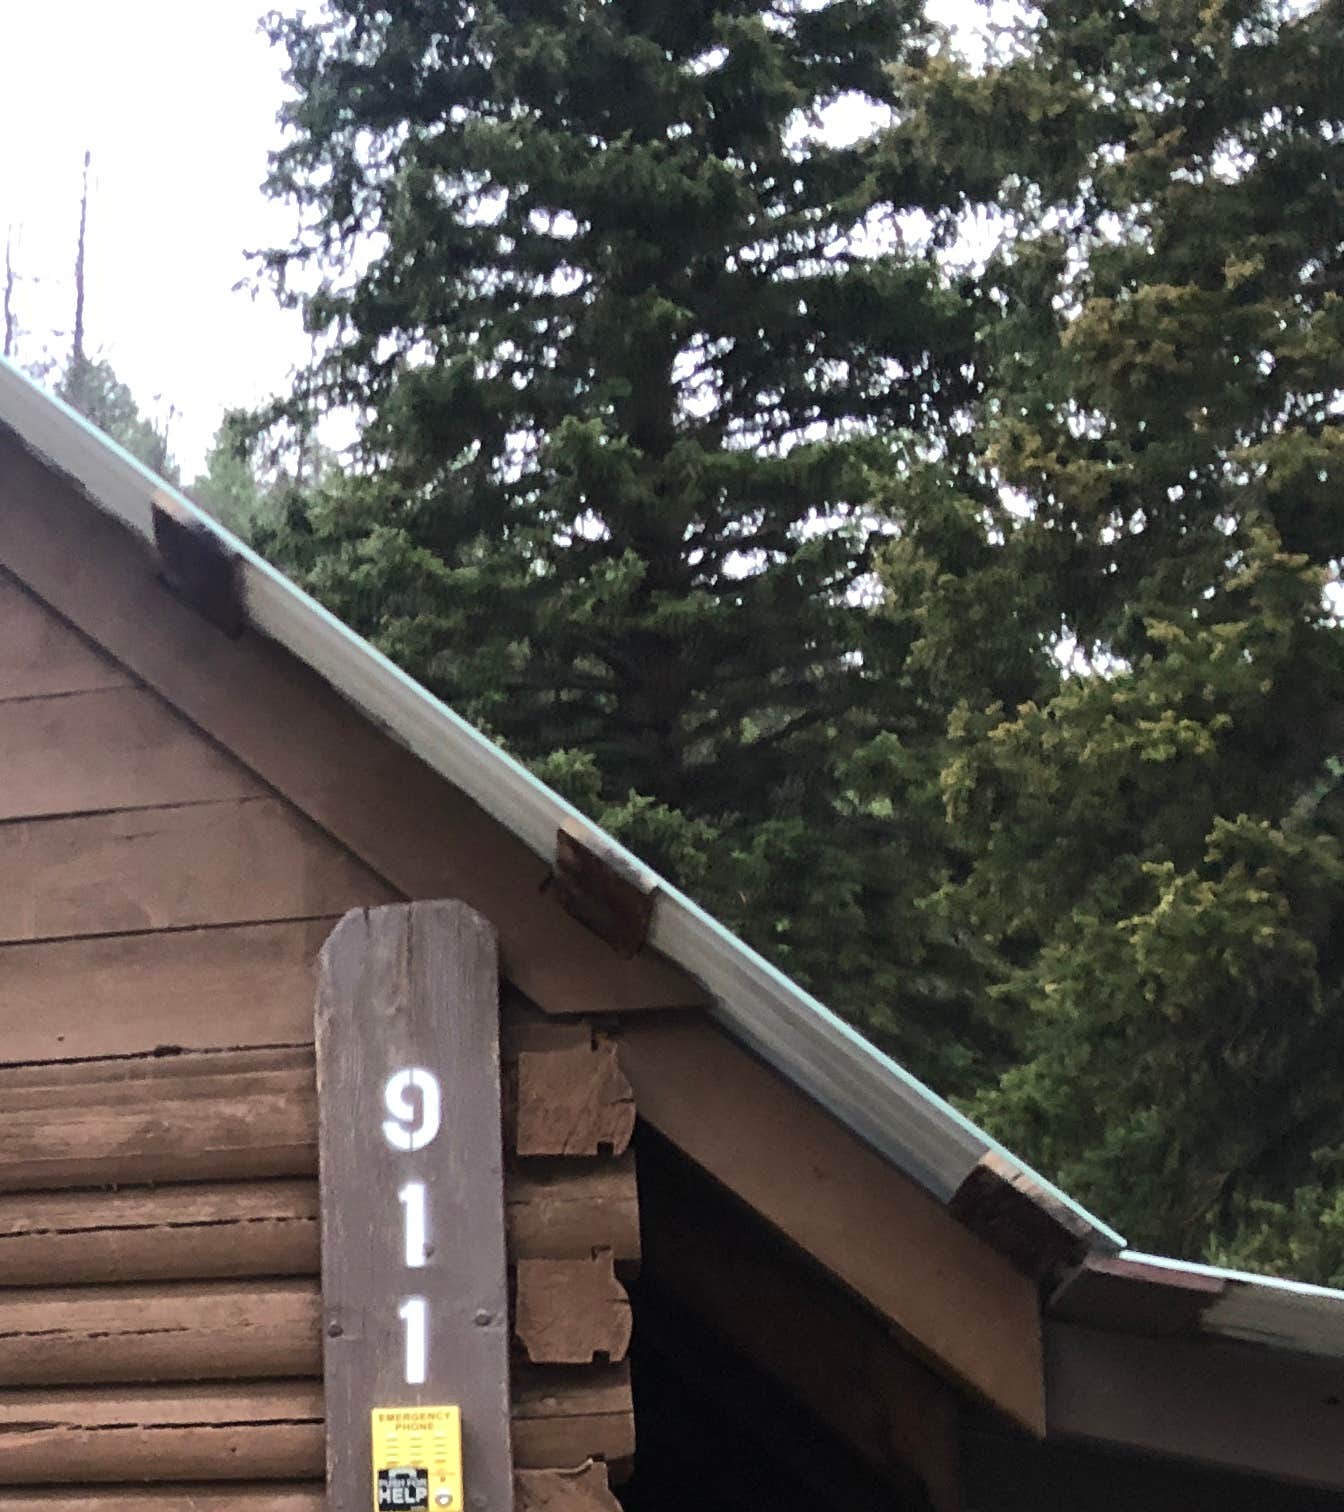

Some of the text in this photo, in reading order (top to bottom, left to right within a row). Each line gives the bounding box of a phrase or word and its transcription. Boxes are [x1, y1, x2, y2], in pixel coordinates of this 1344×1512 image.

[381, 1066, 442, 1386] 911
[378, 1412, 451, 1422] EMERGENCY
[395, 1422, 434, 1431] PHONE
[378, 1487, 428, 1504] HELP
